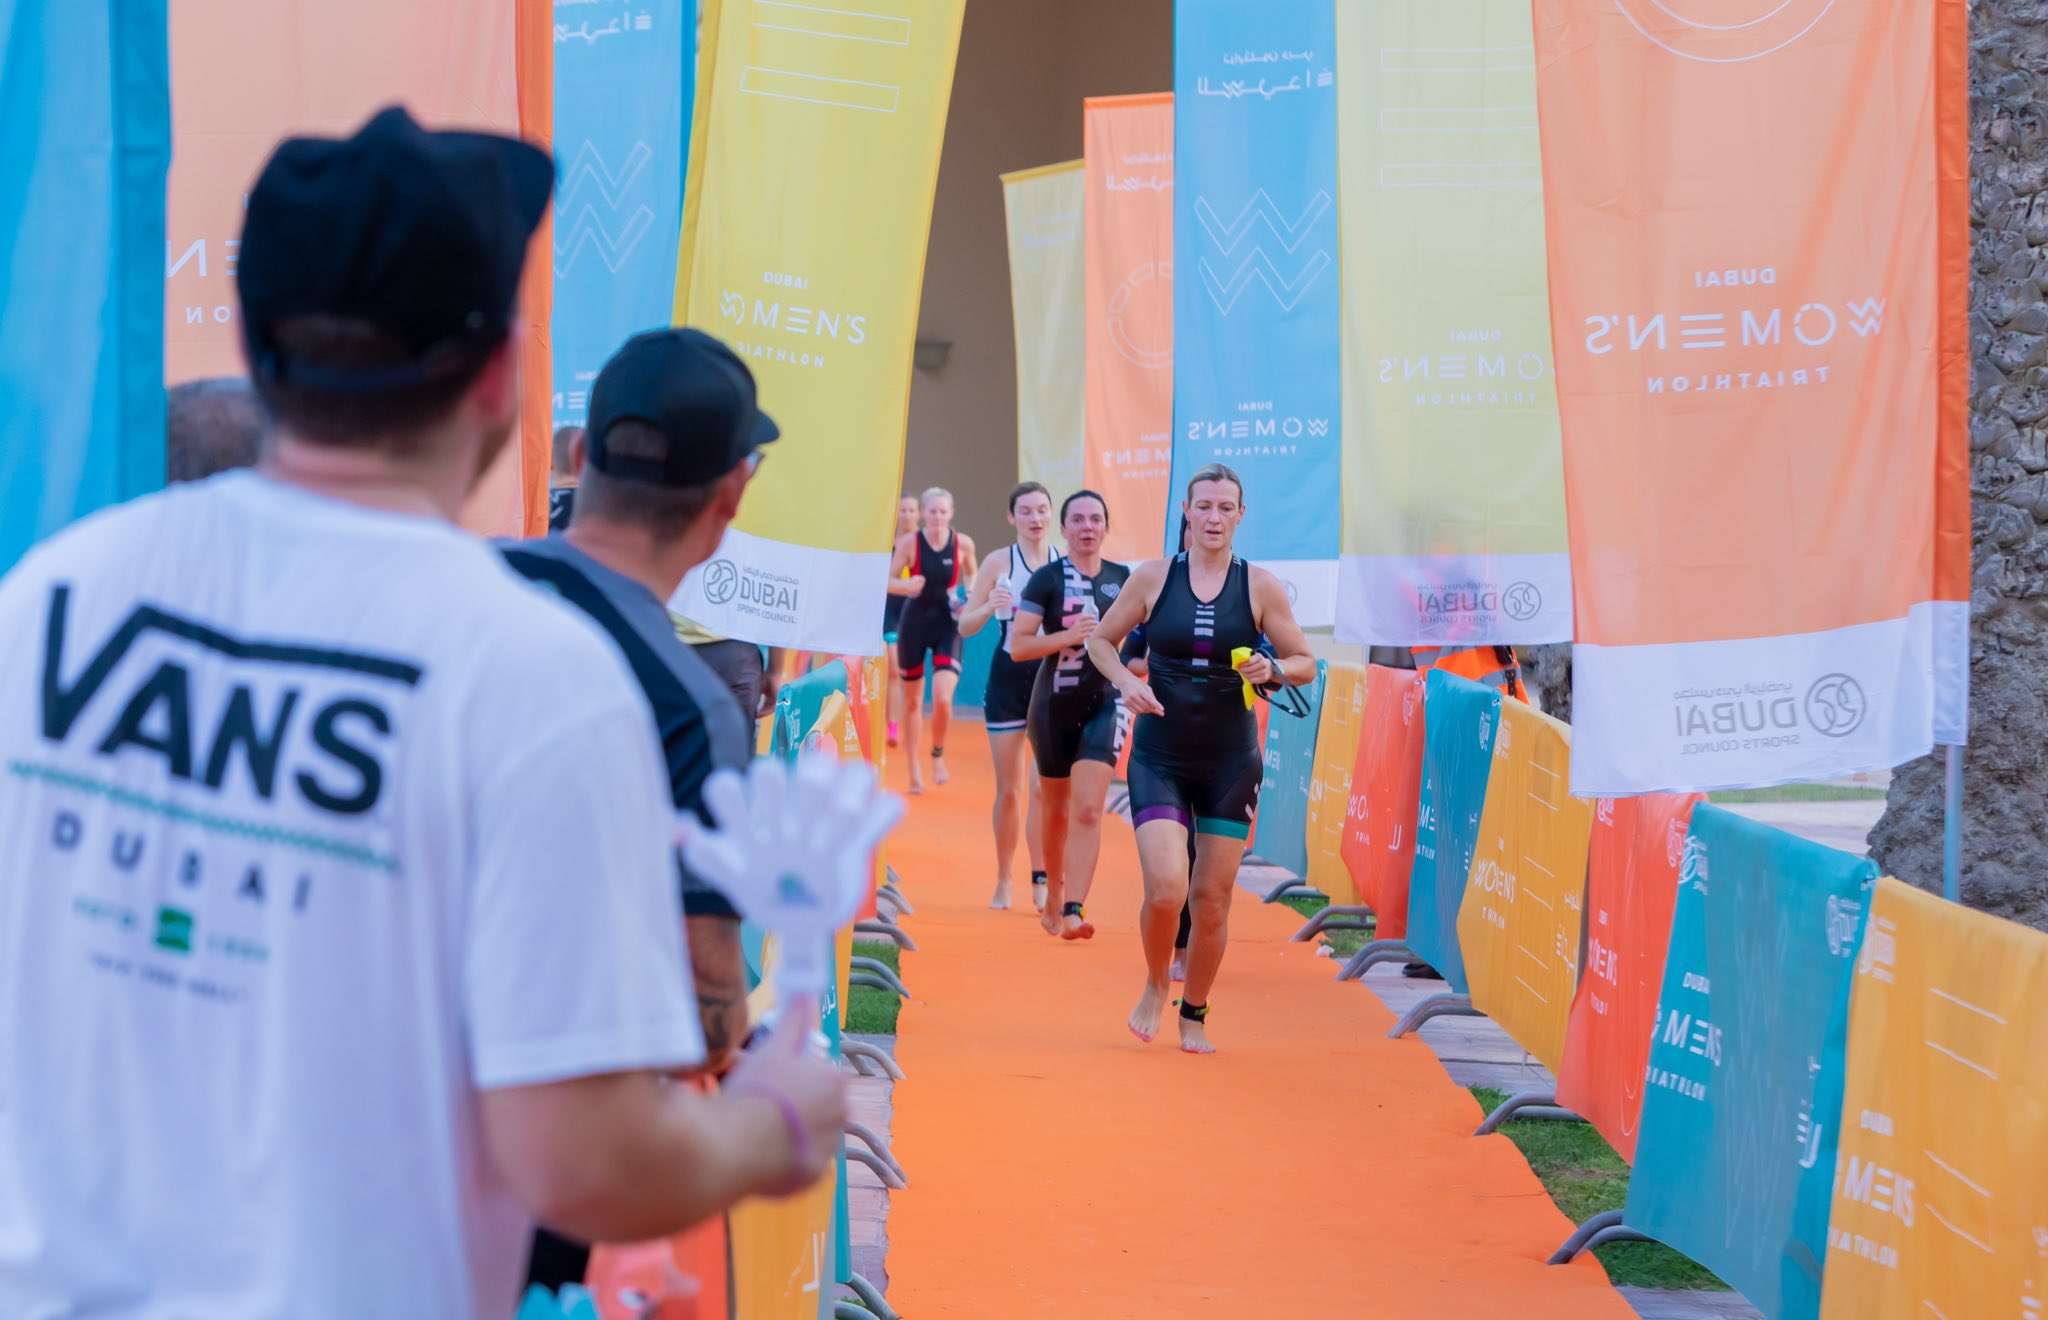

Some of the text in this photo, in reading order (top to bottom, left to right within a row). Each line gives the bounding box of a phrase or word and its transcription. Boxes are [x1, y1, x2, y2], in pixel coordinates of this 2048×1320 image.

[762, 271, 808, 288] DUBAI
[737, 341, 825, 368] RIATHLON
[740, 576, 798, 611] DUBAI
[761, 609, 798, 624] COUNCIL
[41, 583, 424, 819] VANS
[52, 808, 311, 914] DUBAI
